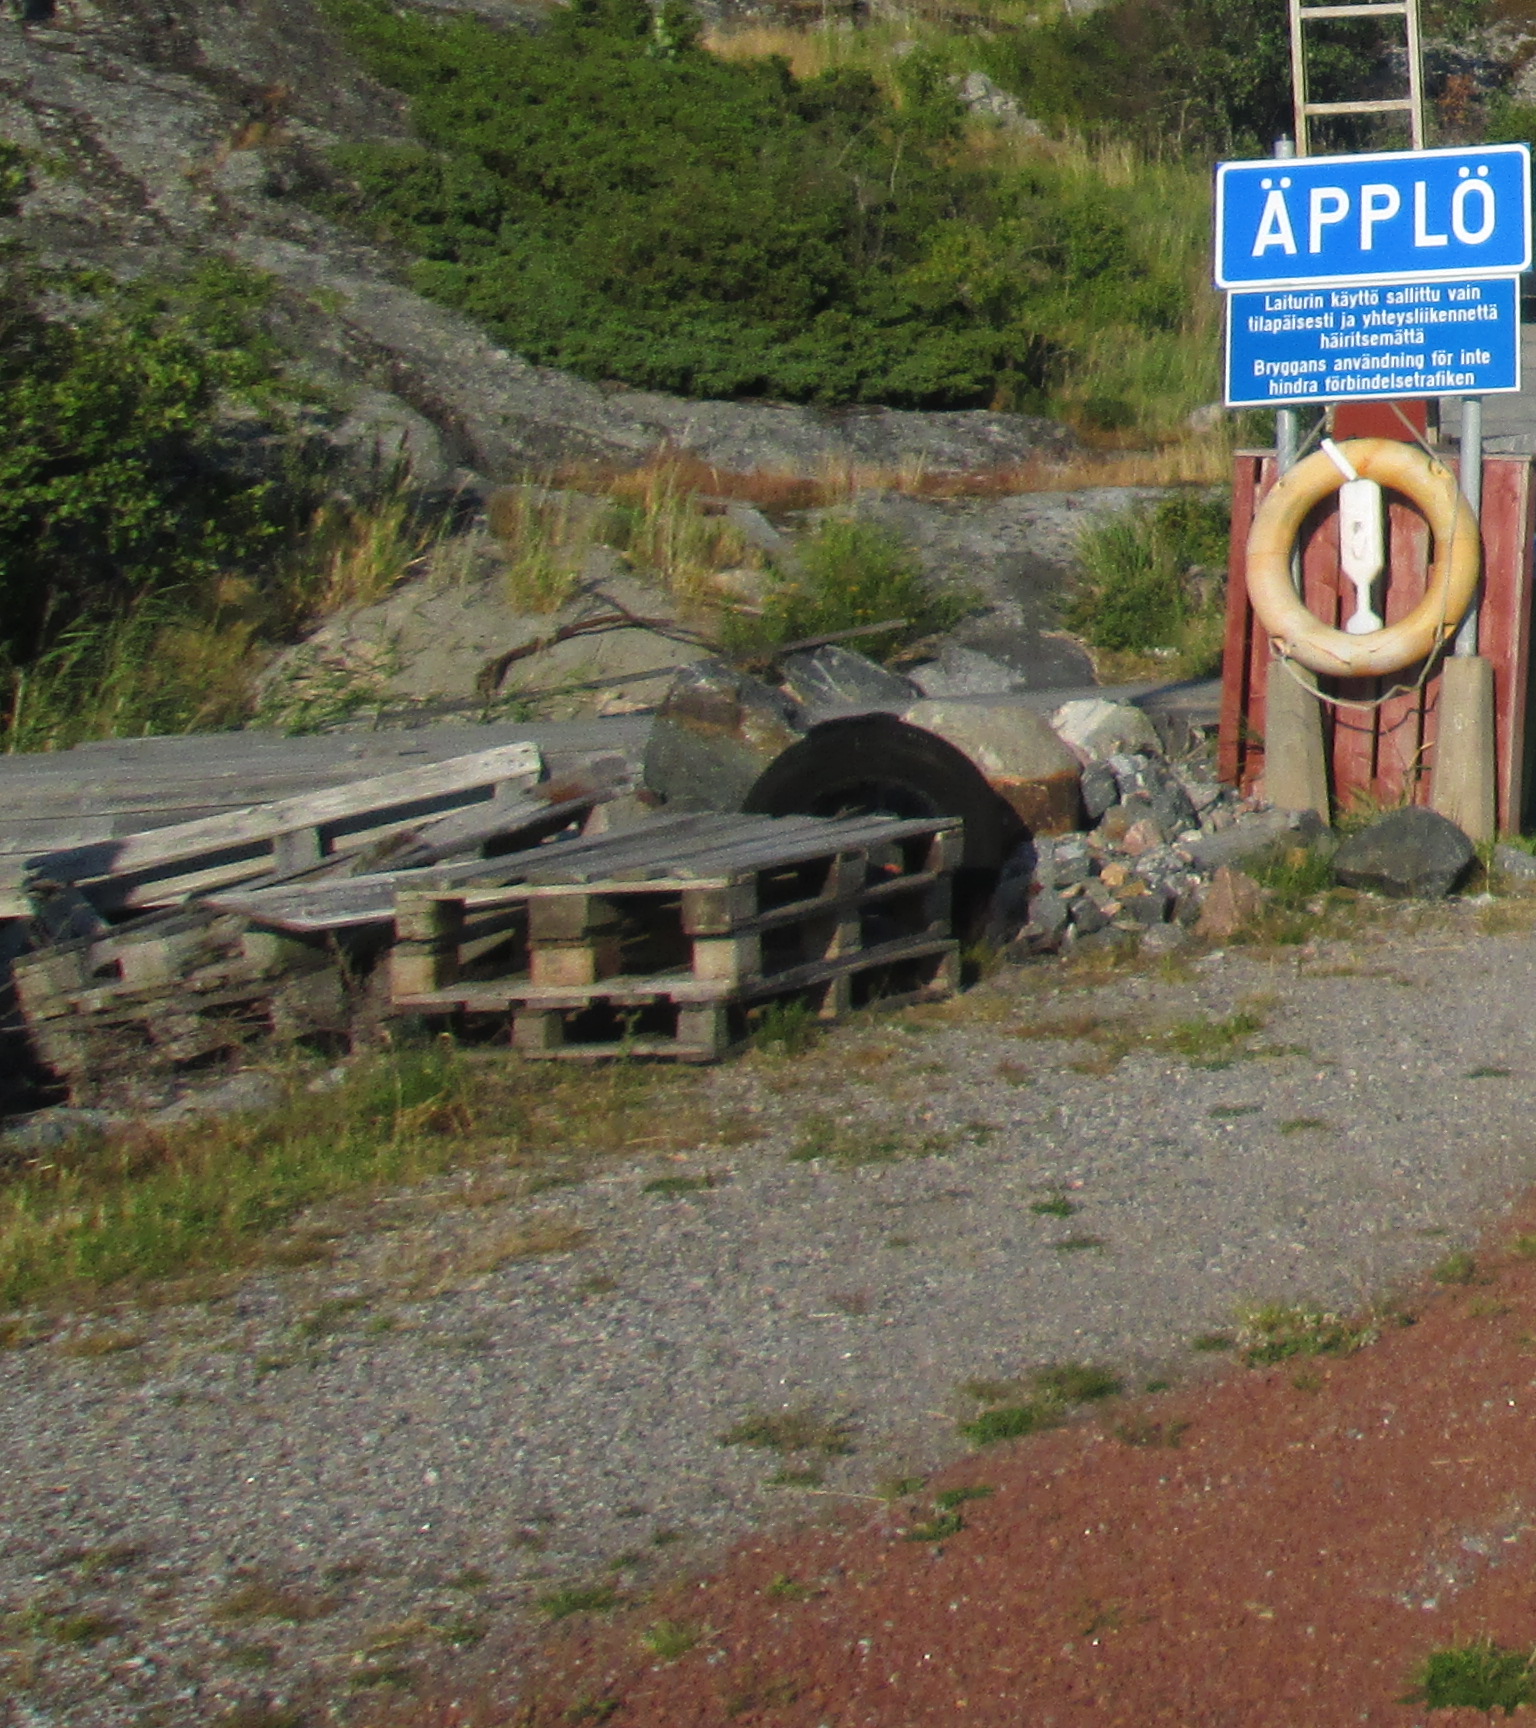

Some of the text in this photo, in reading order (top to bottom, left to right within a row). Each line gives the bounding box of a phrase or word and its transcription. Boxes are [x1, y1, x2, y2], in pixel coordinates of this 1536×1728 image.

[1251, 165, 1496, 257] ÄPPLÖ
[1264, 284, 1481, 312] Laiturin käyttö sallittu vain
[1248, 304, 1498, 334] tilapäisesti ja yhteysliikennettä
[1320, 329, 1424, 349] häiritsemättä
[1254, 348, 1491, 377] Bryggans användning för inte
[1268, 370, 1474, 396] hindra förbindelsetrafiken
